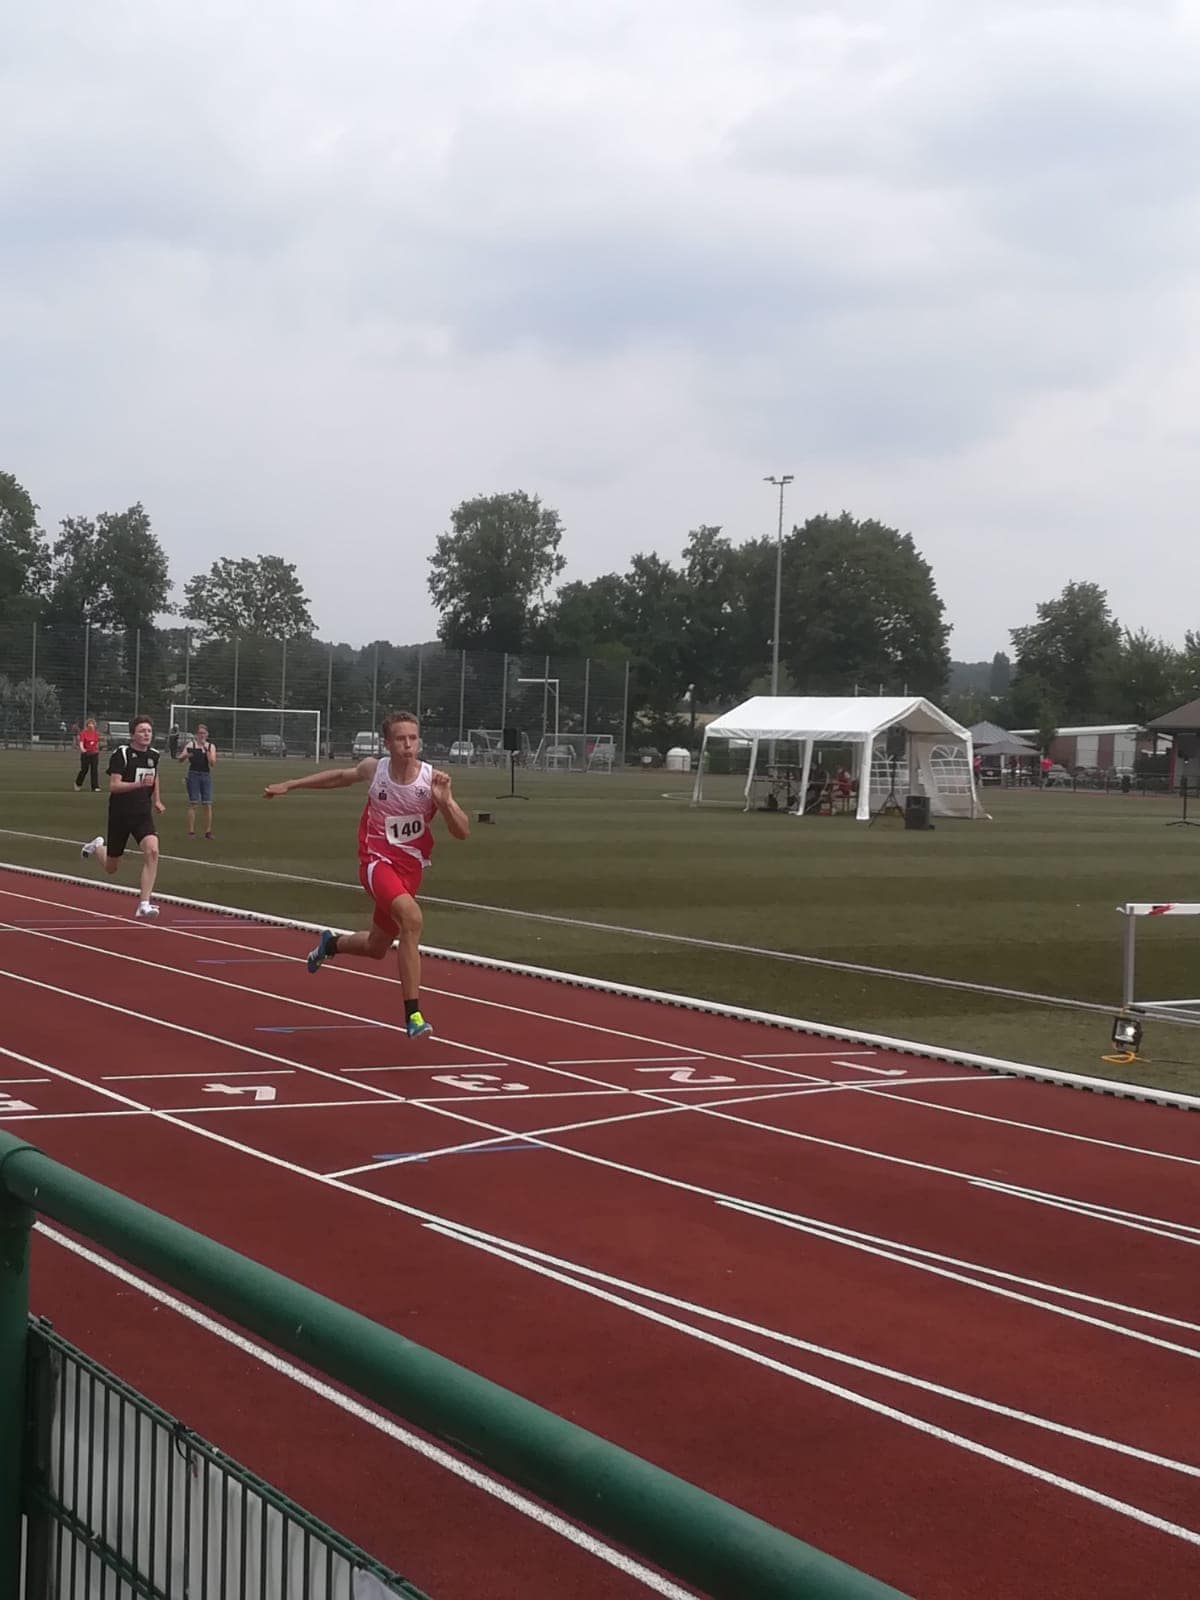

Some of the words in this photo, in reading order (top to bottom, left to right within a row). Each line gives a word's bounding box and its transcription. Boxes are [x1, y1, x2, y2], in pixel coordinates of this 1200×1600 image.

[389, 820, 422, 839] 140
[634, 1066, 737, 1083] 2
[831, 1060, 909, 1077] 1
[202, 1083, 277, 1101] 4
[431, 1074, 530, 1092] 3
